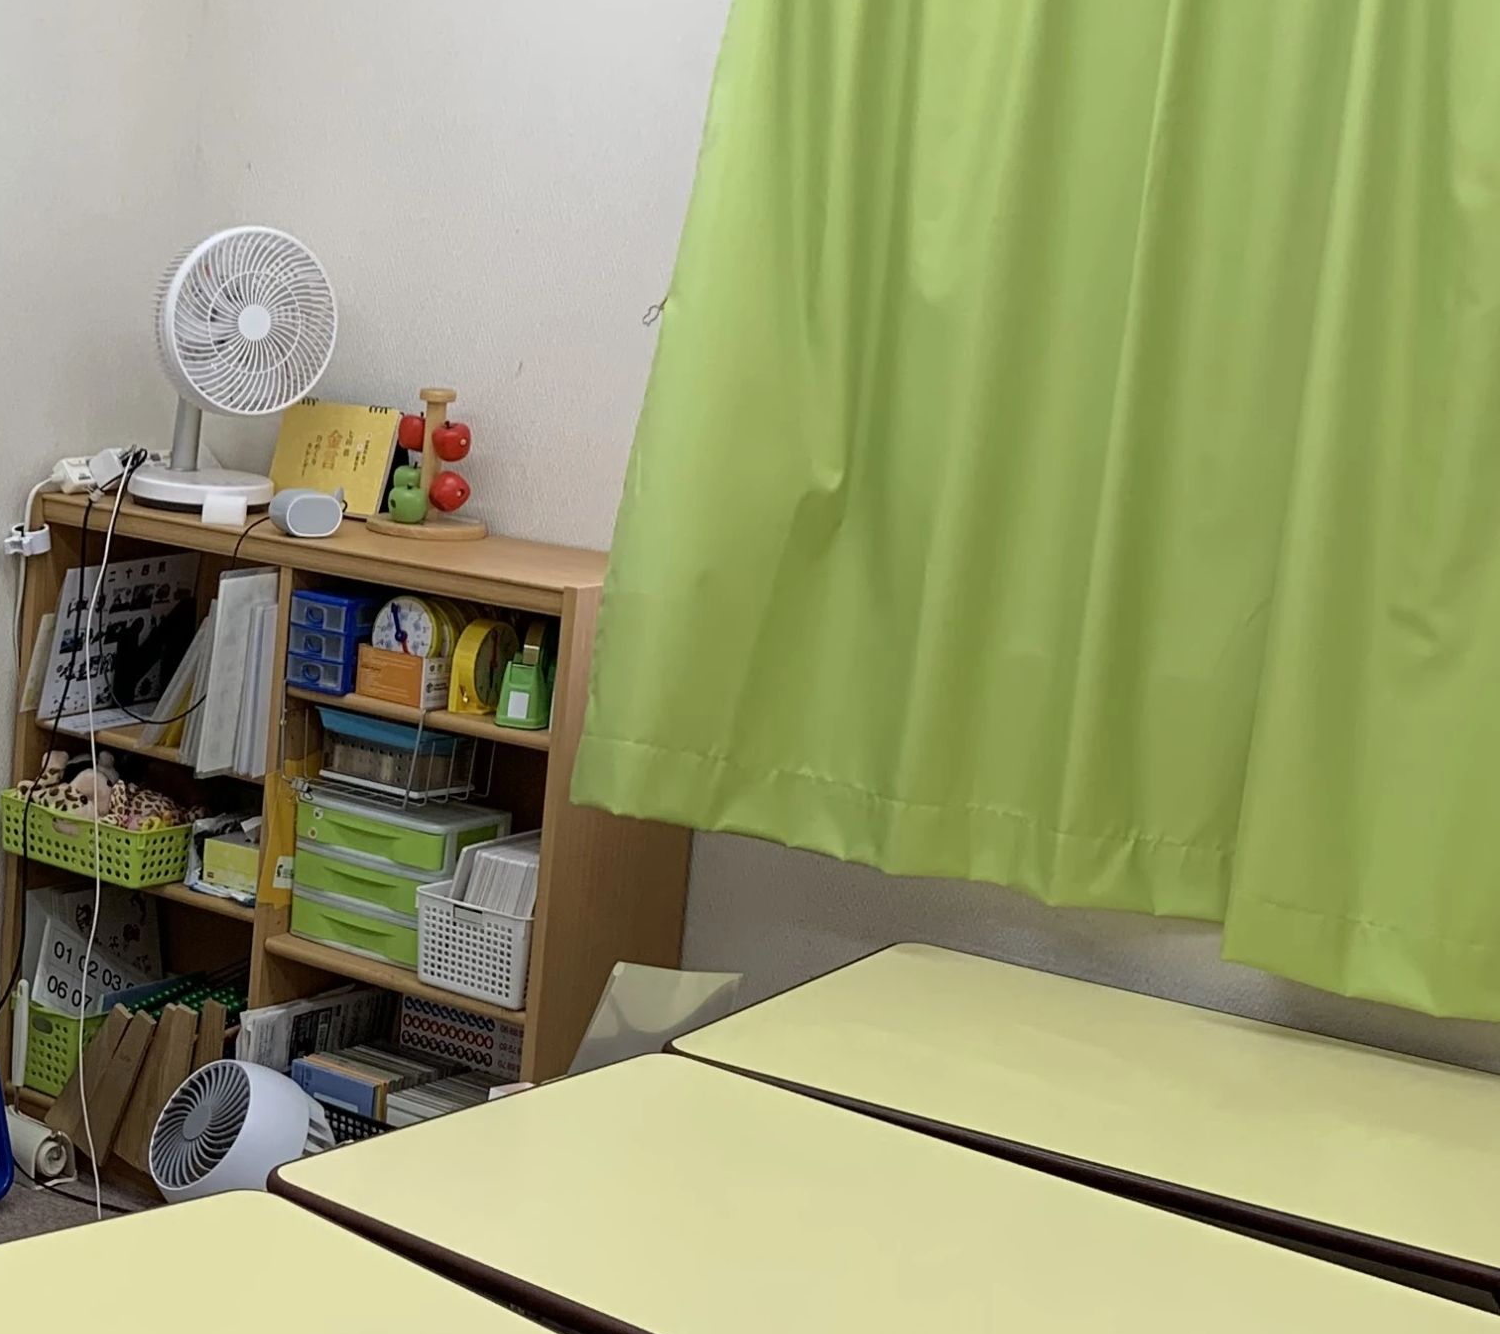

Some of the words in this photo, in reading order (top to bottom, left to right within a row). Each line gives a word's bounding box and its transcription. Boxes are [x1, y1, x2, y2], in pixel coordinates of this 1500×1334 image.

[54, 942, 72, 964] 01
[102, 969, 121, 991] 03
[48, 976, 68, 998] 06
[72, 990, 92, 1009] 07
